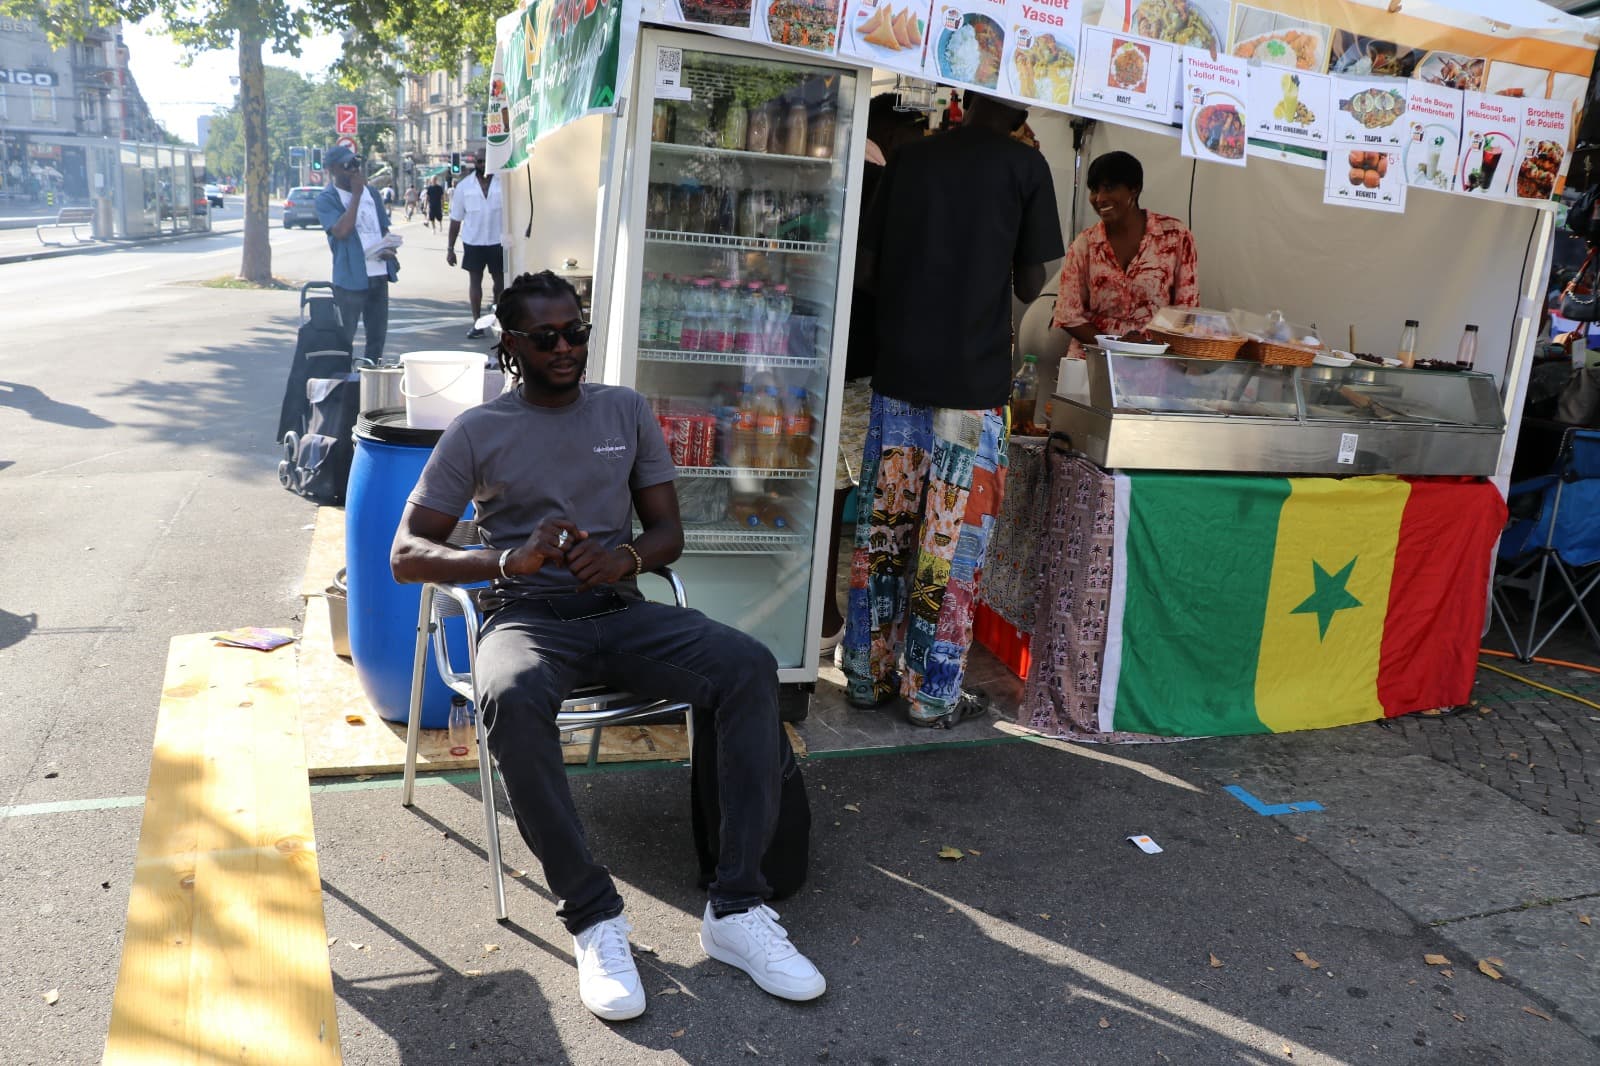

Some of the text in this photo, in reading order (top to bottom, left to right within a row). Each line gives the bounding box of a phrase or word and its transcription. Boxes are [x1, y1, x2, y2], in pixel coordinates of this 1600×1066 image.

[1022, 4, 1065, 27] Yassa
[1411, 94, 1422, 103] Jus
[1424, 96, 1432, 104] de
[1480, 102, 1503, 113] Bissap
[1527, 107, 1565, 120] Brochette
[1526, 117, 1565, 130] de Poulets
